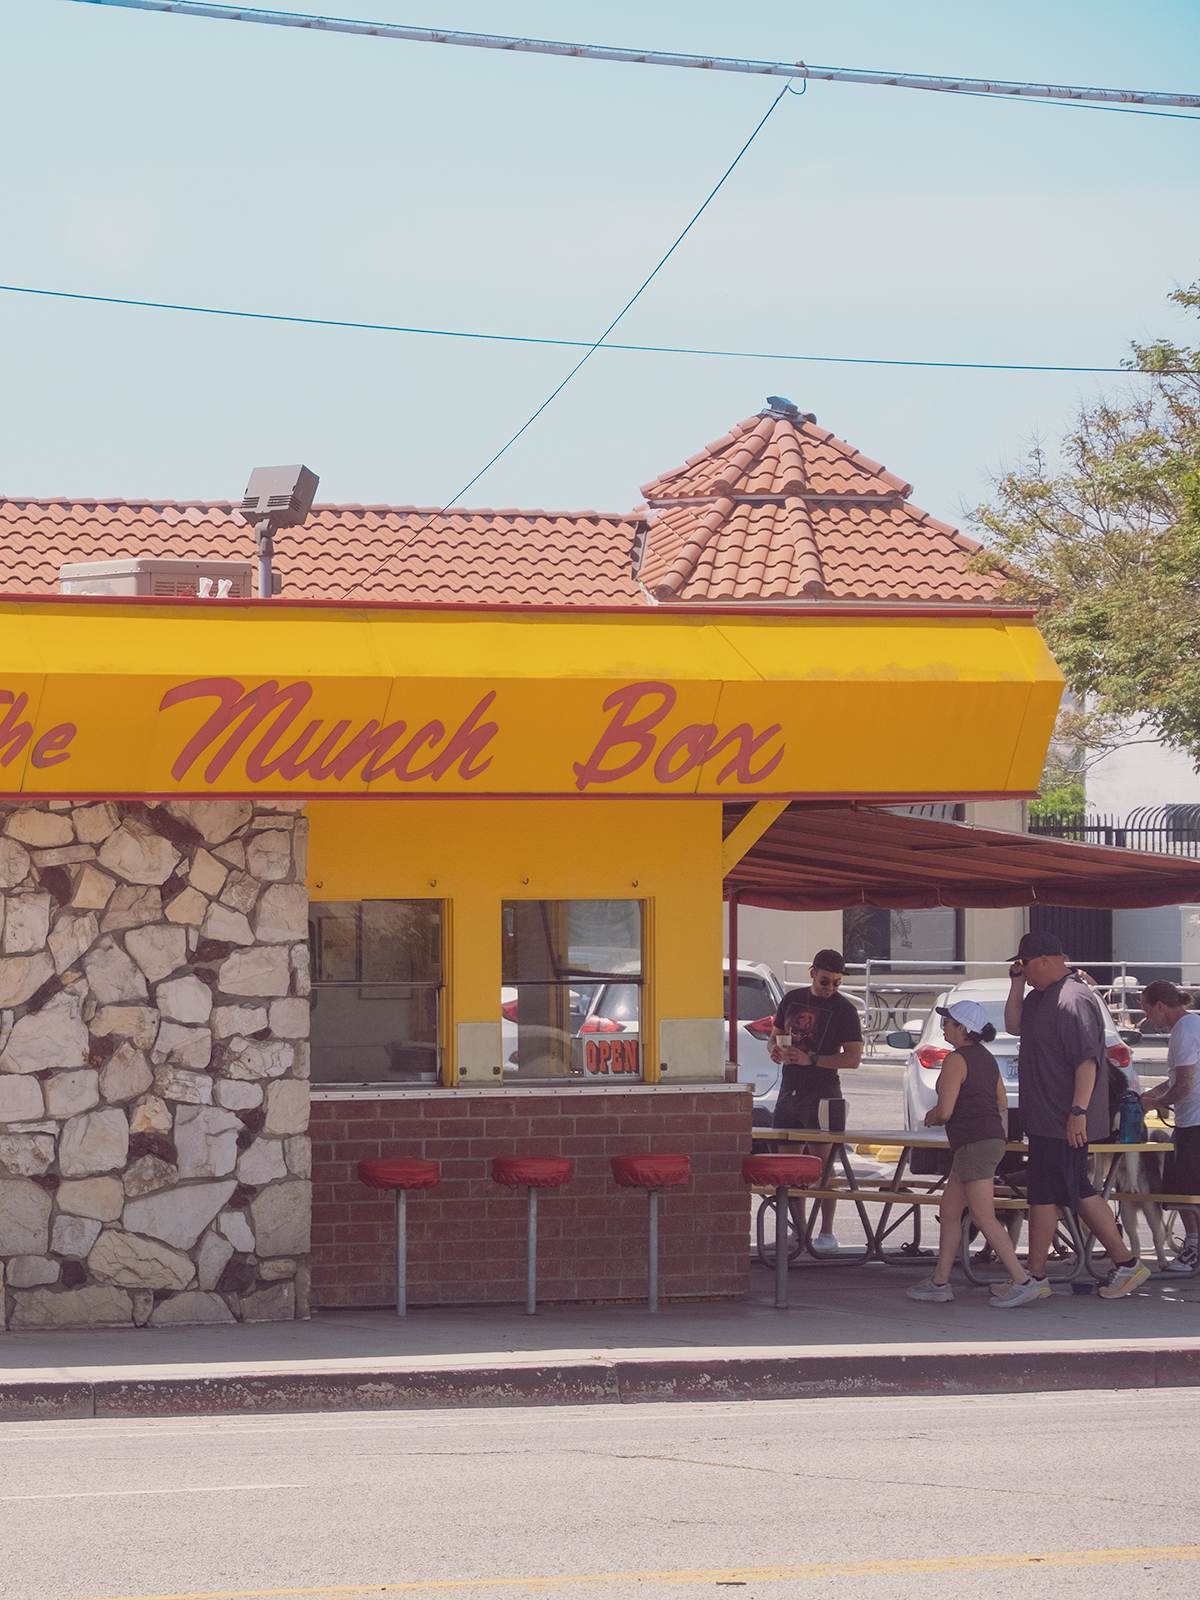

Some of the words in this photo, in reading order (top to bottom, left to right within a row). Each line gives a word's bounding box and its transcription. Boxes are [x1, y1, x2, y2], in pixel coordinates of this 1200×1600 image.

[158, 677, 499, 784] Munch
[572, 680, 787, 792] Box
[586, 1040, 639, 1075] OPEN
